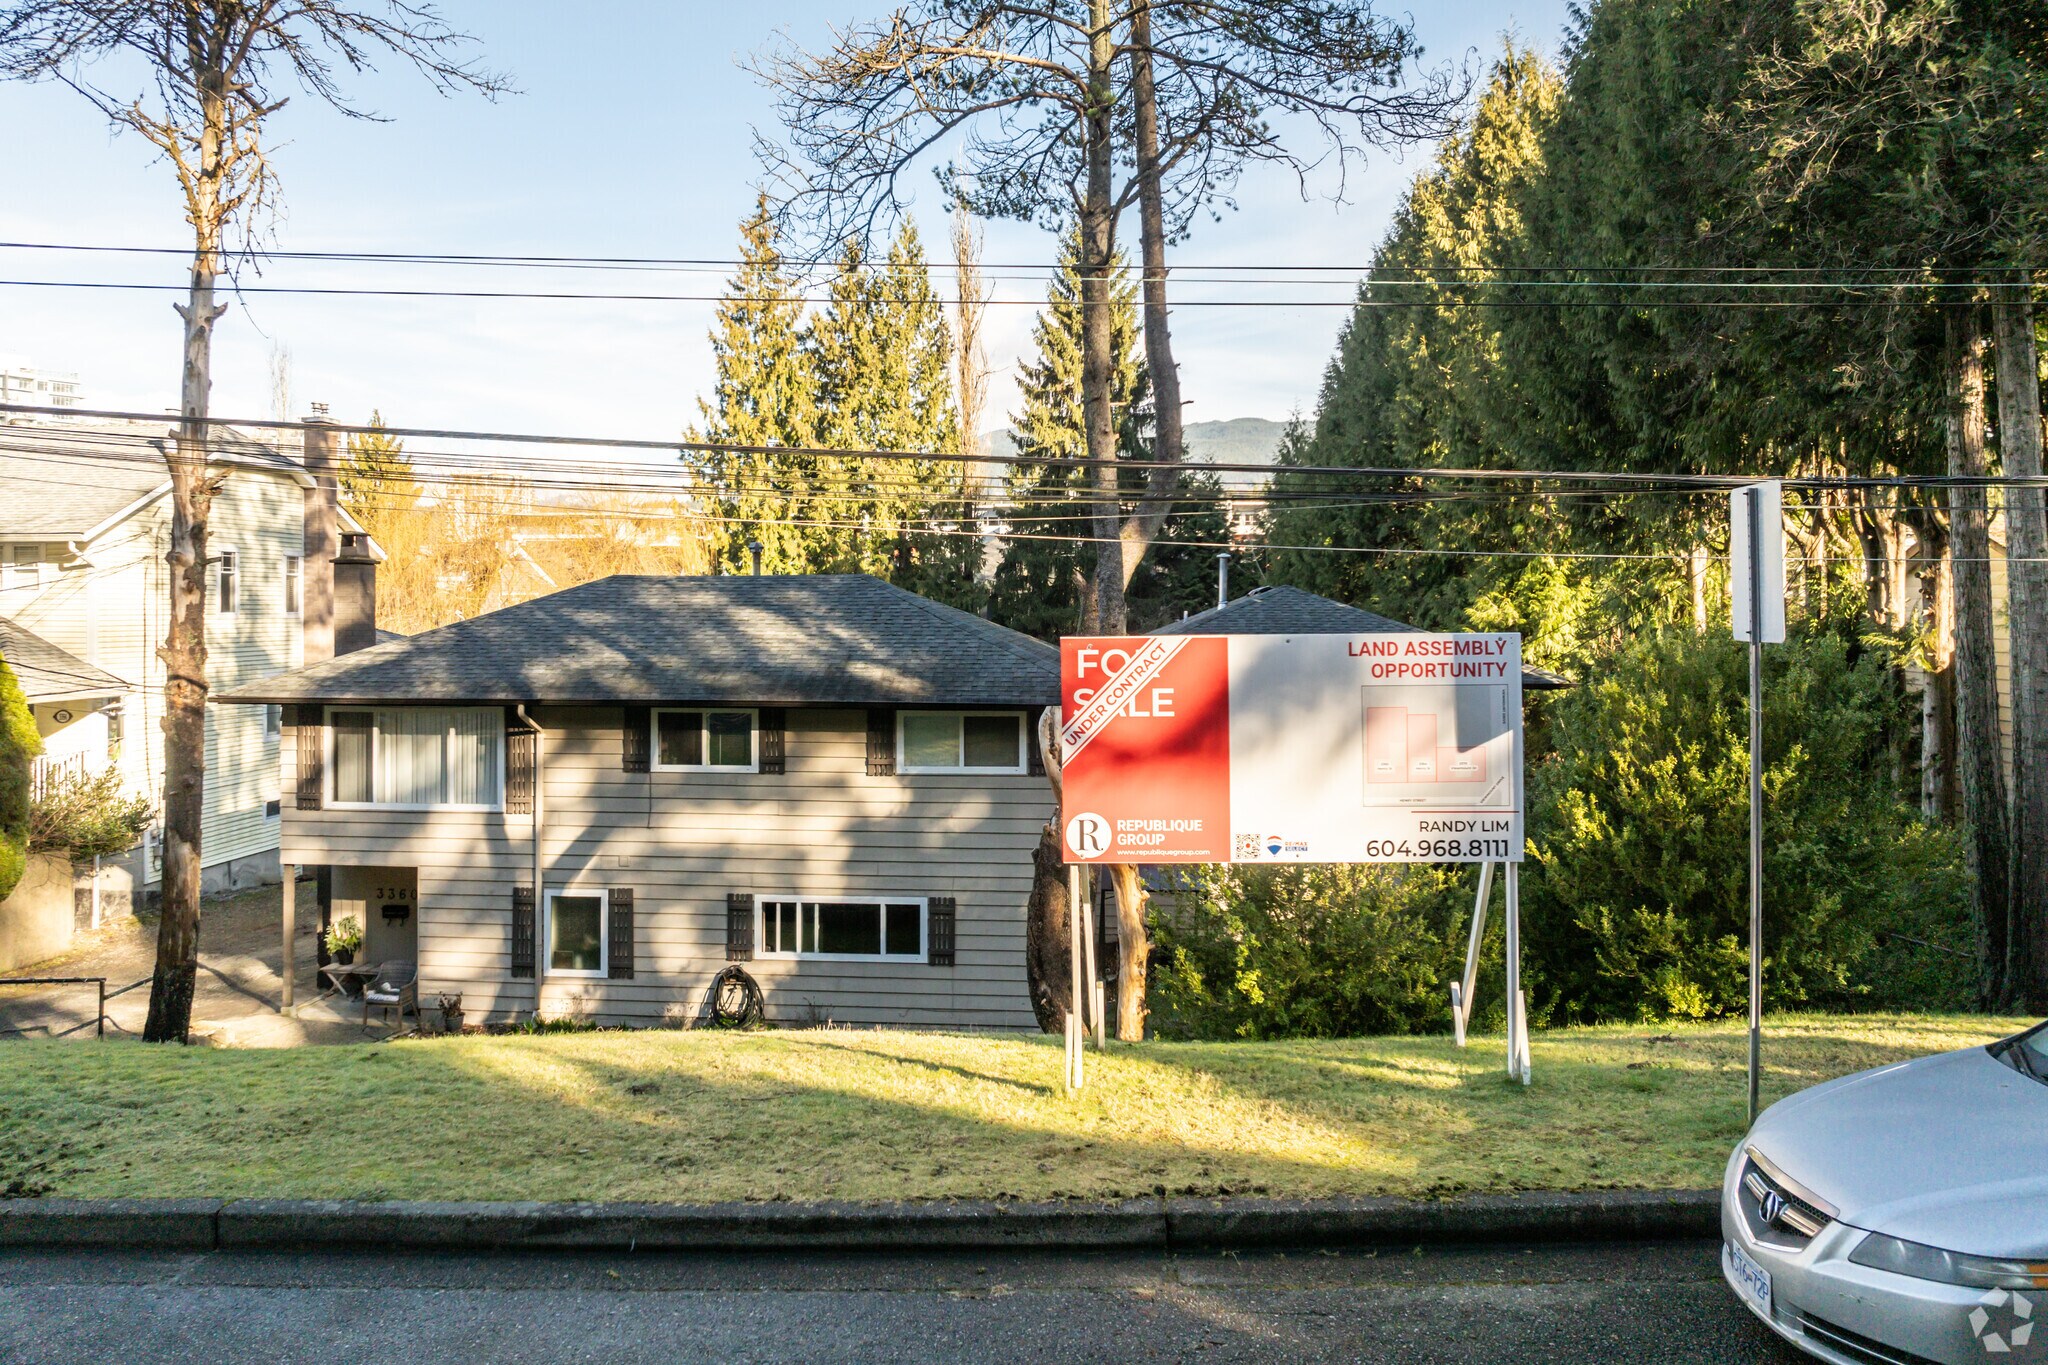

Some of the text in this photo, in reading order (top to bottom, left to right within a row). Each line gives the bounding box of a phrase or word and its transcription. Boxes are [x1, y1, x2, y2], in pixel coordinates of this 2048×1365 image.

[1348, 640, 1507, 657] LAND ASSEMBLY
[1077, 648, 1160, 679] FO
[1371, 662, 1508, 678] OPPORTUNITY
[1065, 643, 1166, 747] UNDER CONTRACT
[1073, 688, 1175, 717] SLE
[1117, 819, 1203, 832] REPUBLIQUE
[1419, 820, 1509, 832] RANDY LIM
[1117, 834, 1165, 846] GROUP
[1366, 839, 1509, 857] 604.968.8111
[1117, 849, 1210, 857] www.republiquegroup.com
[376, 888, 418, 899] 3360
